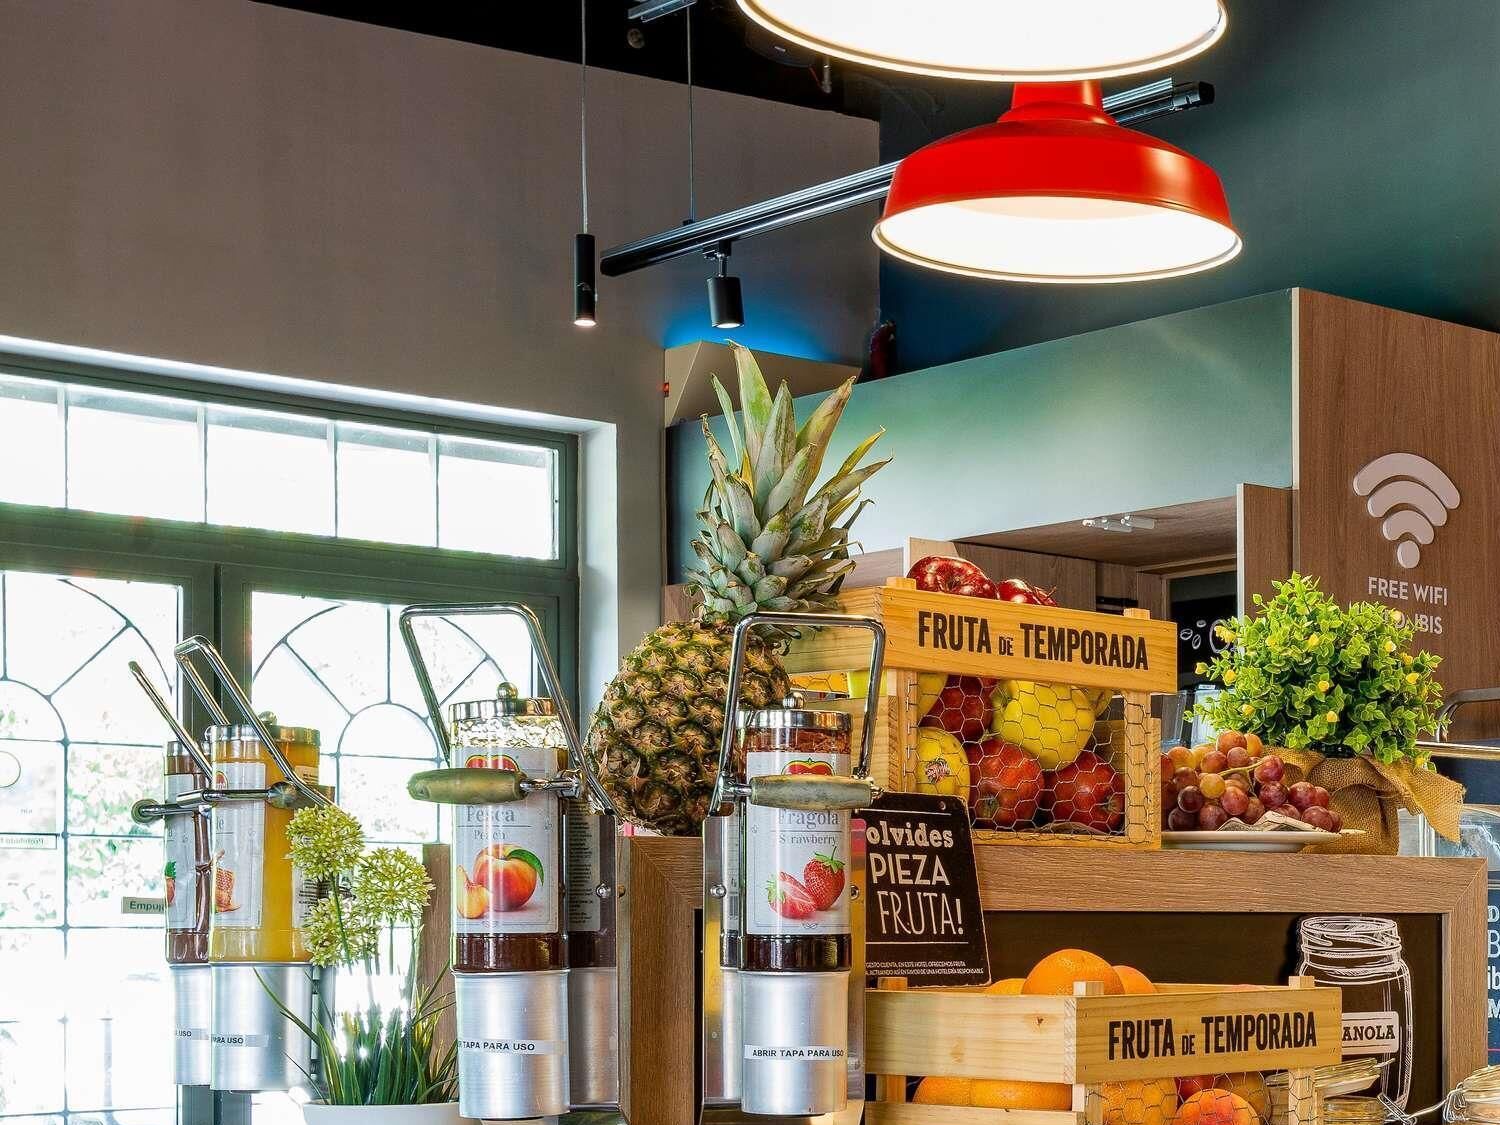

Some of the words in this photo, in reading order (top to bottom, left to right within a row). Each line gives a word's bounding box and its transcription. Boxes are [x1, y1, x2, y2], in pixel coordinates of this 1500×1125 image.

[1368, 576, 1408, 600] FREE
[1413, 583, 1447, 606] WIFI
[918, 610, 992, 654] FRUTA
[999, 635, 1014, 656] DE
[1019, 622, 1149, 671] TEMPORADA
[780, 833, 838, 847] Srawberry
[866, 820, 954, 848] olvides
[869, 853, 950, 886] PIEZA
[877, 891, 964, 935] FRUTA!
[463, 1041, 480, 1049] TAPA
[483, 1042, 509, 1050] PARA
[1108, 1018, 1175, 1060] FRUTA
[1181, 1034, 1196, 1055] DE
[1201, 1011, 1317, 1054] TEMPORADA
[1342, 1025, 1396, 1041] ANOLA
[752, 1049, 776, 1057] ABRIR
[780, 1049, 804, 1057] TAPA
[807, 1049, 830, 1057] PARA
[831, 1049, 844, 1057] USO
